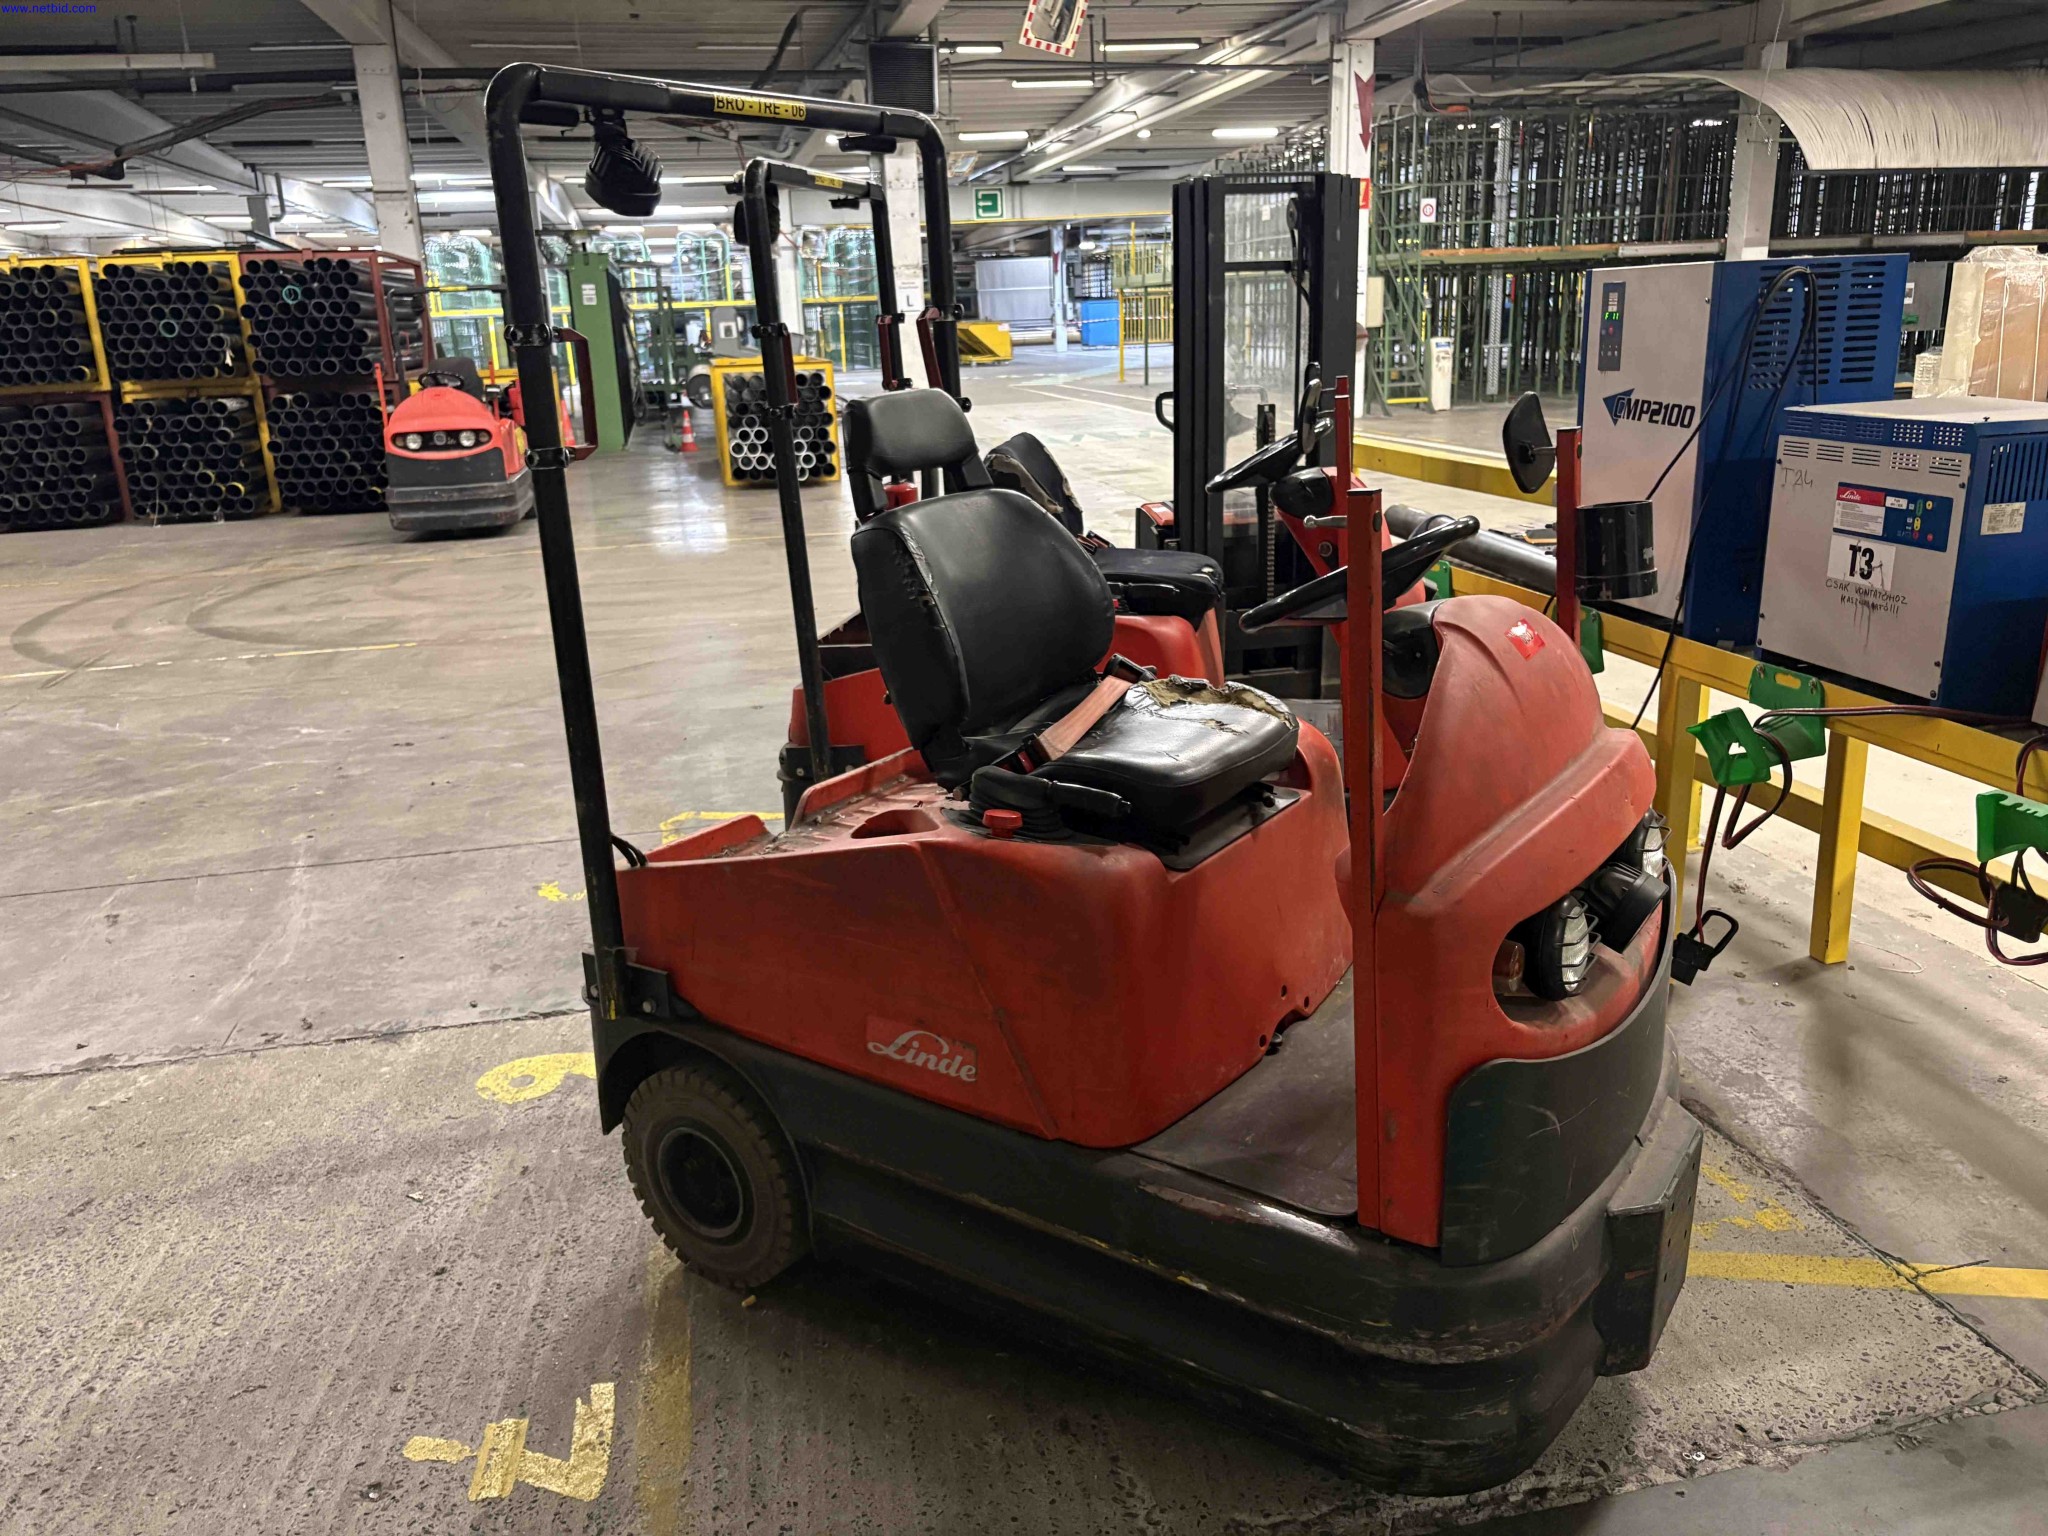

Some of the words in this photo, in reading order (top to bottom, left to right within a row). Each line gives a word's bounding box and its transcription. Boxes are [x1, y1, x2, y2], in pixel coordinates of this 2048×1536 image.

[716, 96, 745, 111] BRO
[791, 105, 805, 118] 06
[1840, 489, 1861, 500] Linde
[1849, 544, 1875, 580] T3
[1826, 579, 1850, 592] CSAK
[867, 1030, 976, 1082] Linde
